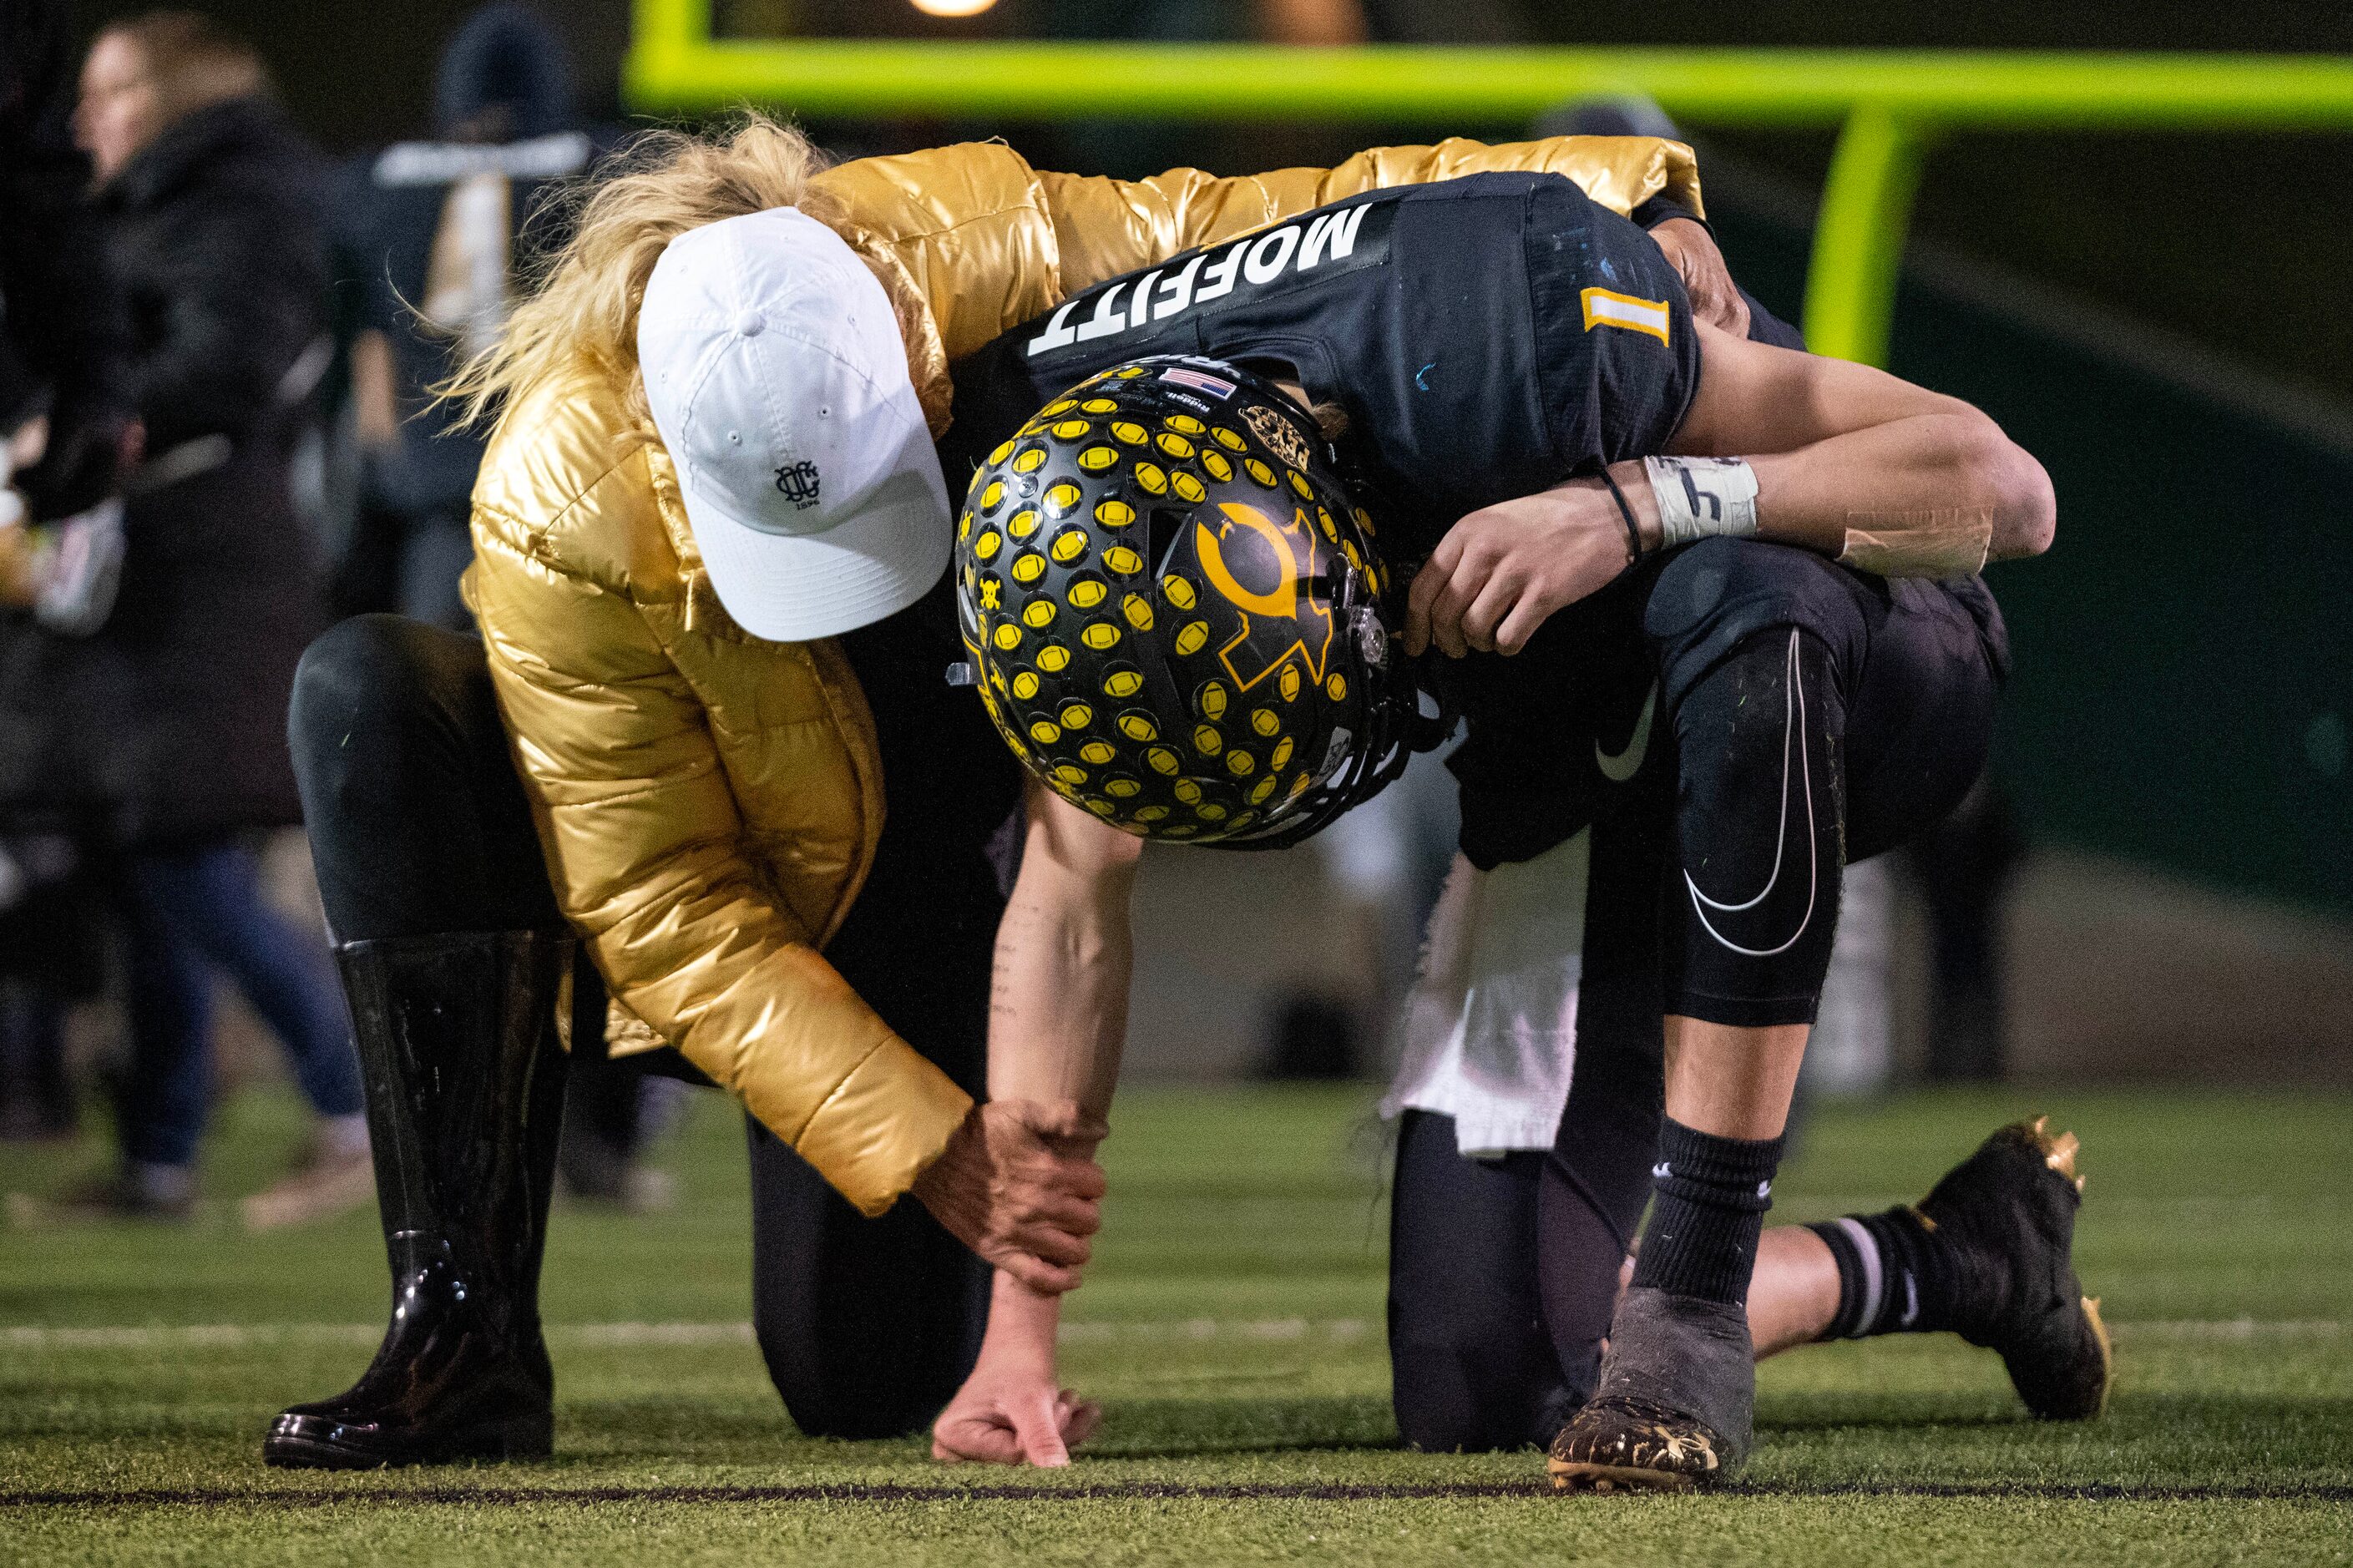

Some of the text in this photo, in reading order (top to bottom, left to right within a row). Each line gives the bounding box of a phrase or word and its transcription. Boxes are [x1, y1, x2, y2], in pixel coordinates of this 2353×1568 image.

[1027, 203, 1373, 357] MOFFITT
[1581, 287, 1669, 347] 1
[1167, 392, 1210, 412] Riddell
